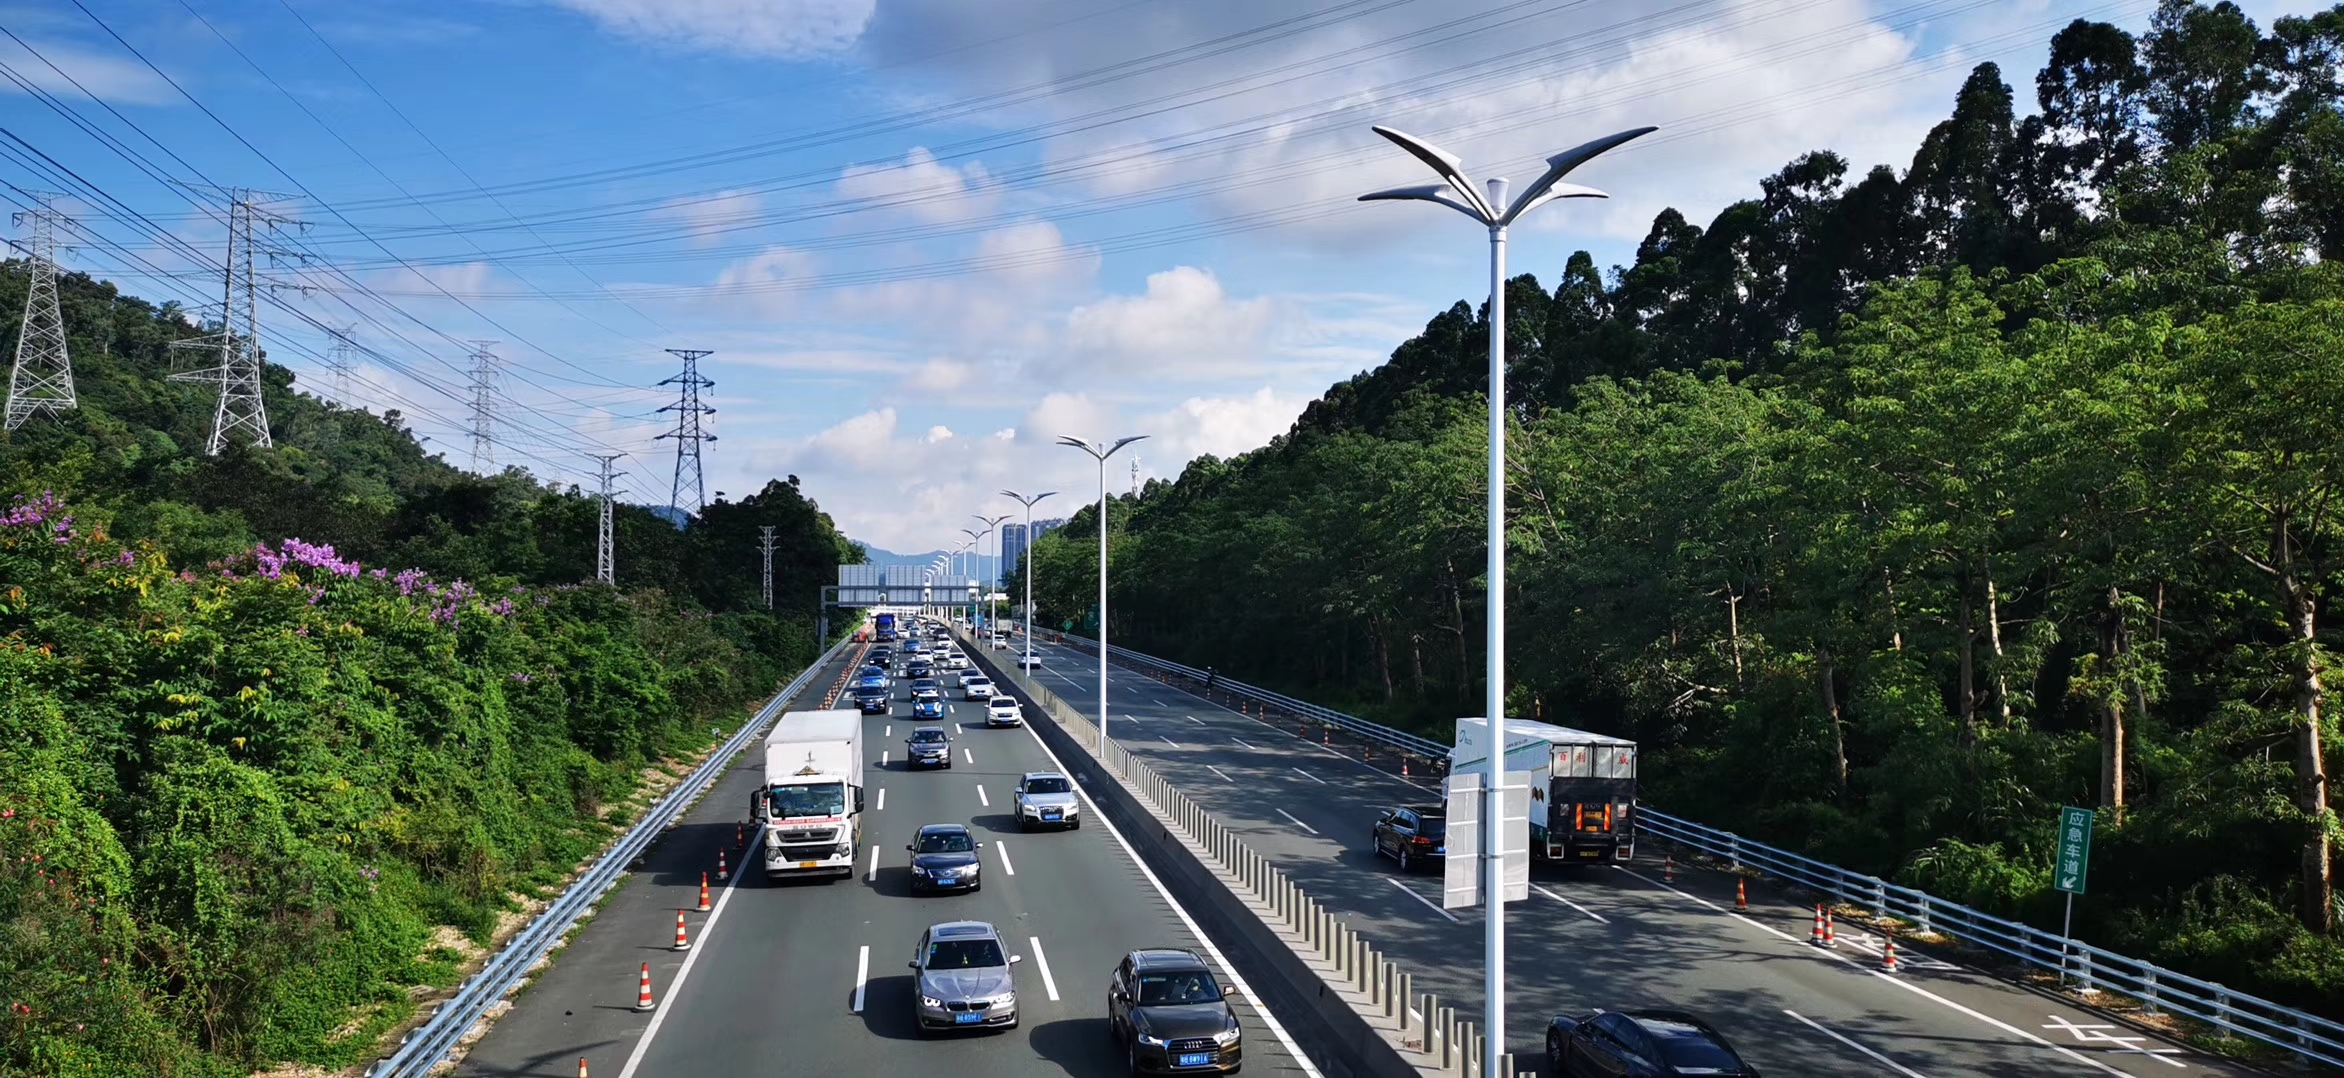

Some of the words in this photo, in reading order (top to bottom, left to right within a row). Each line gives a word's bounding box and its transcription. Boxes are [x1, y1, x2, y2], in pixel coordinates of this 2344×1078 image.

[2063, 811, 2085, 876] 应急车道
[2041, 1015, 2187, 1068] 车
